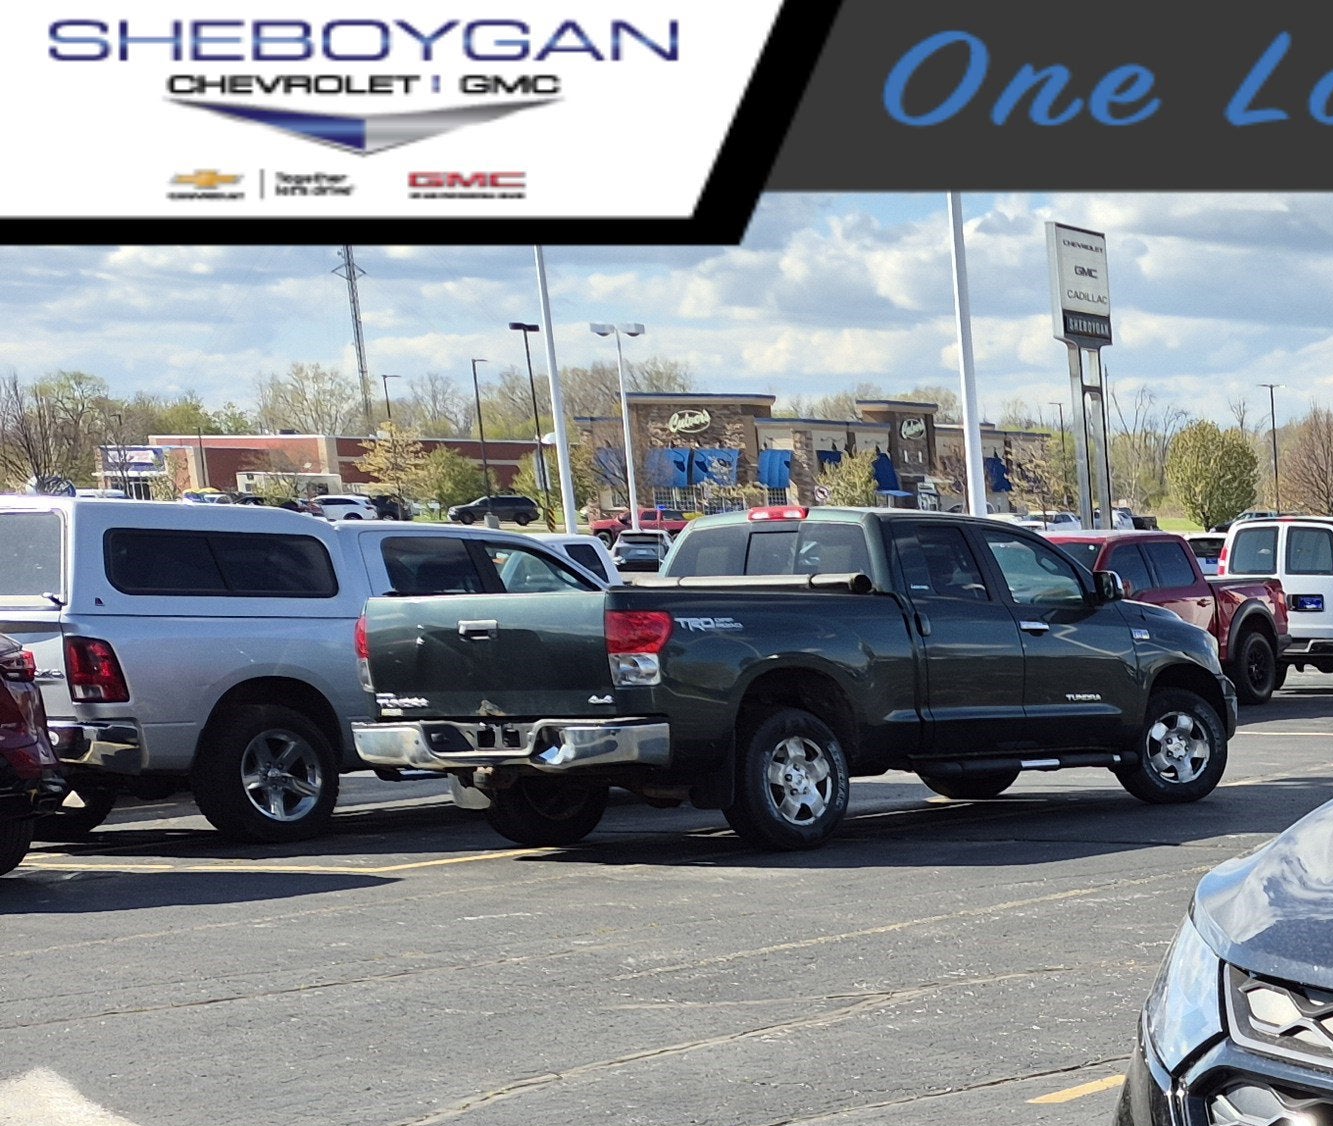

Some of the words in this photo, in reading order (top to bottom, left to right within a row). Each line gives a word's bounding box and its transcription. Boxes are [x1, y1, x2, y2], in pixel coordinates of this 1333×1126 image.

[1063, 240, 1103, 253] CHEVROLET
[1074, 265, 1098, 279] GMC
[1067, 290, 1107, 305] CADILLAC
[674, 617, 715, 632] TRD
